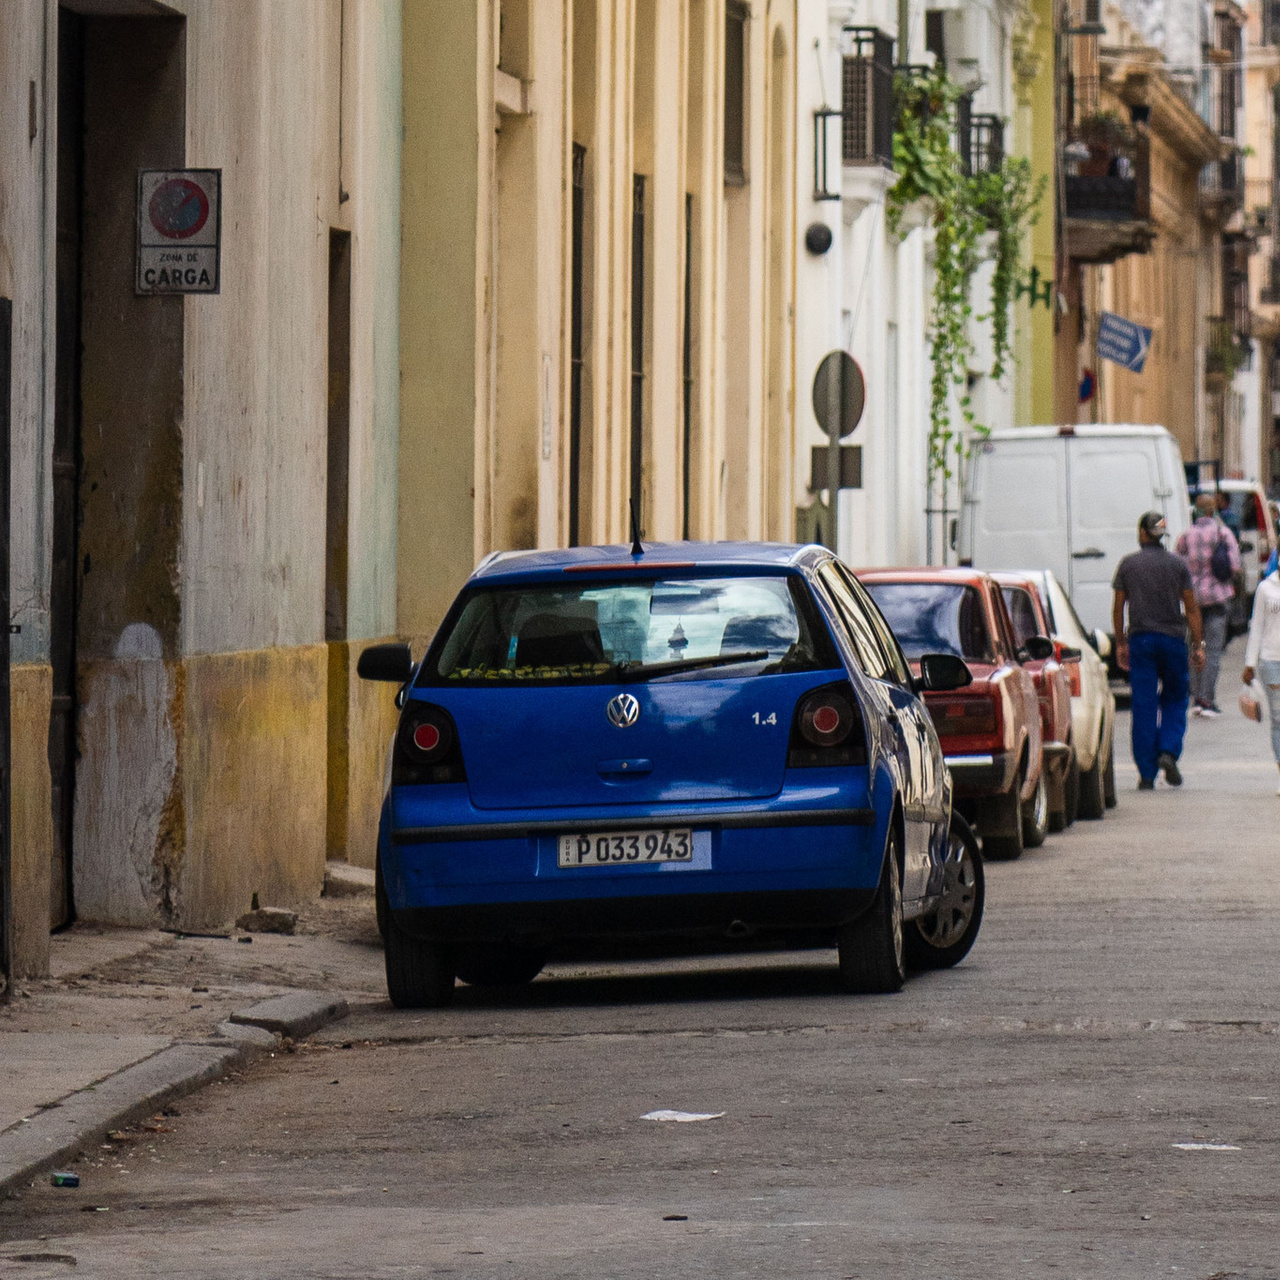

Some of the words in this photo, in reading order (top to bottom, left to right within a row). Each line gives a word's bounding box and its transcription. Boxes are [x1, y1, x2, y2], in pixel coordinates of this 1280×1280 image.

[160, 252, 183, 263] ZONA
[187, 252, 199, 263] DE
[144, 268, 211, 286] CARGA
[752, 712, 778, 726] 1.4
